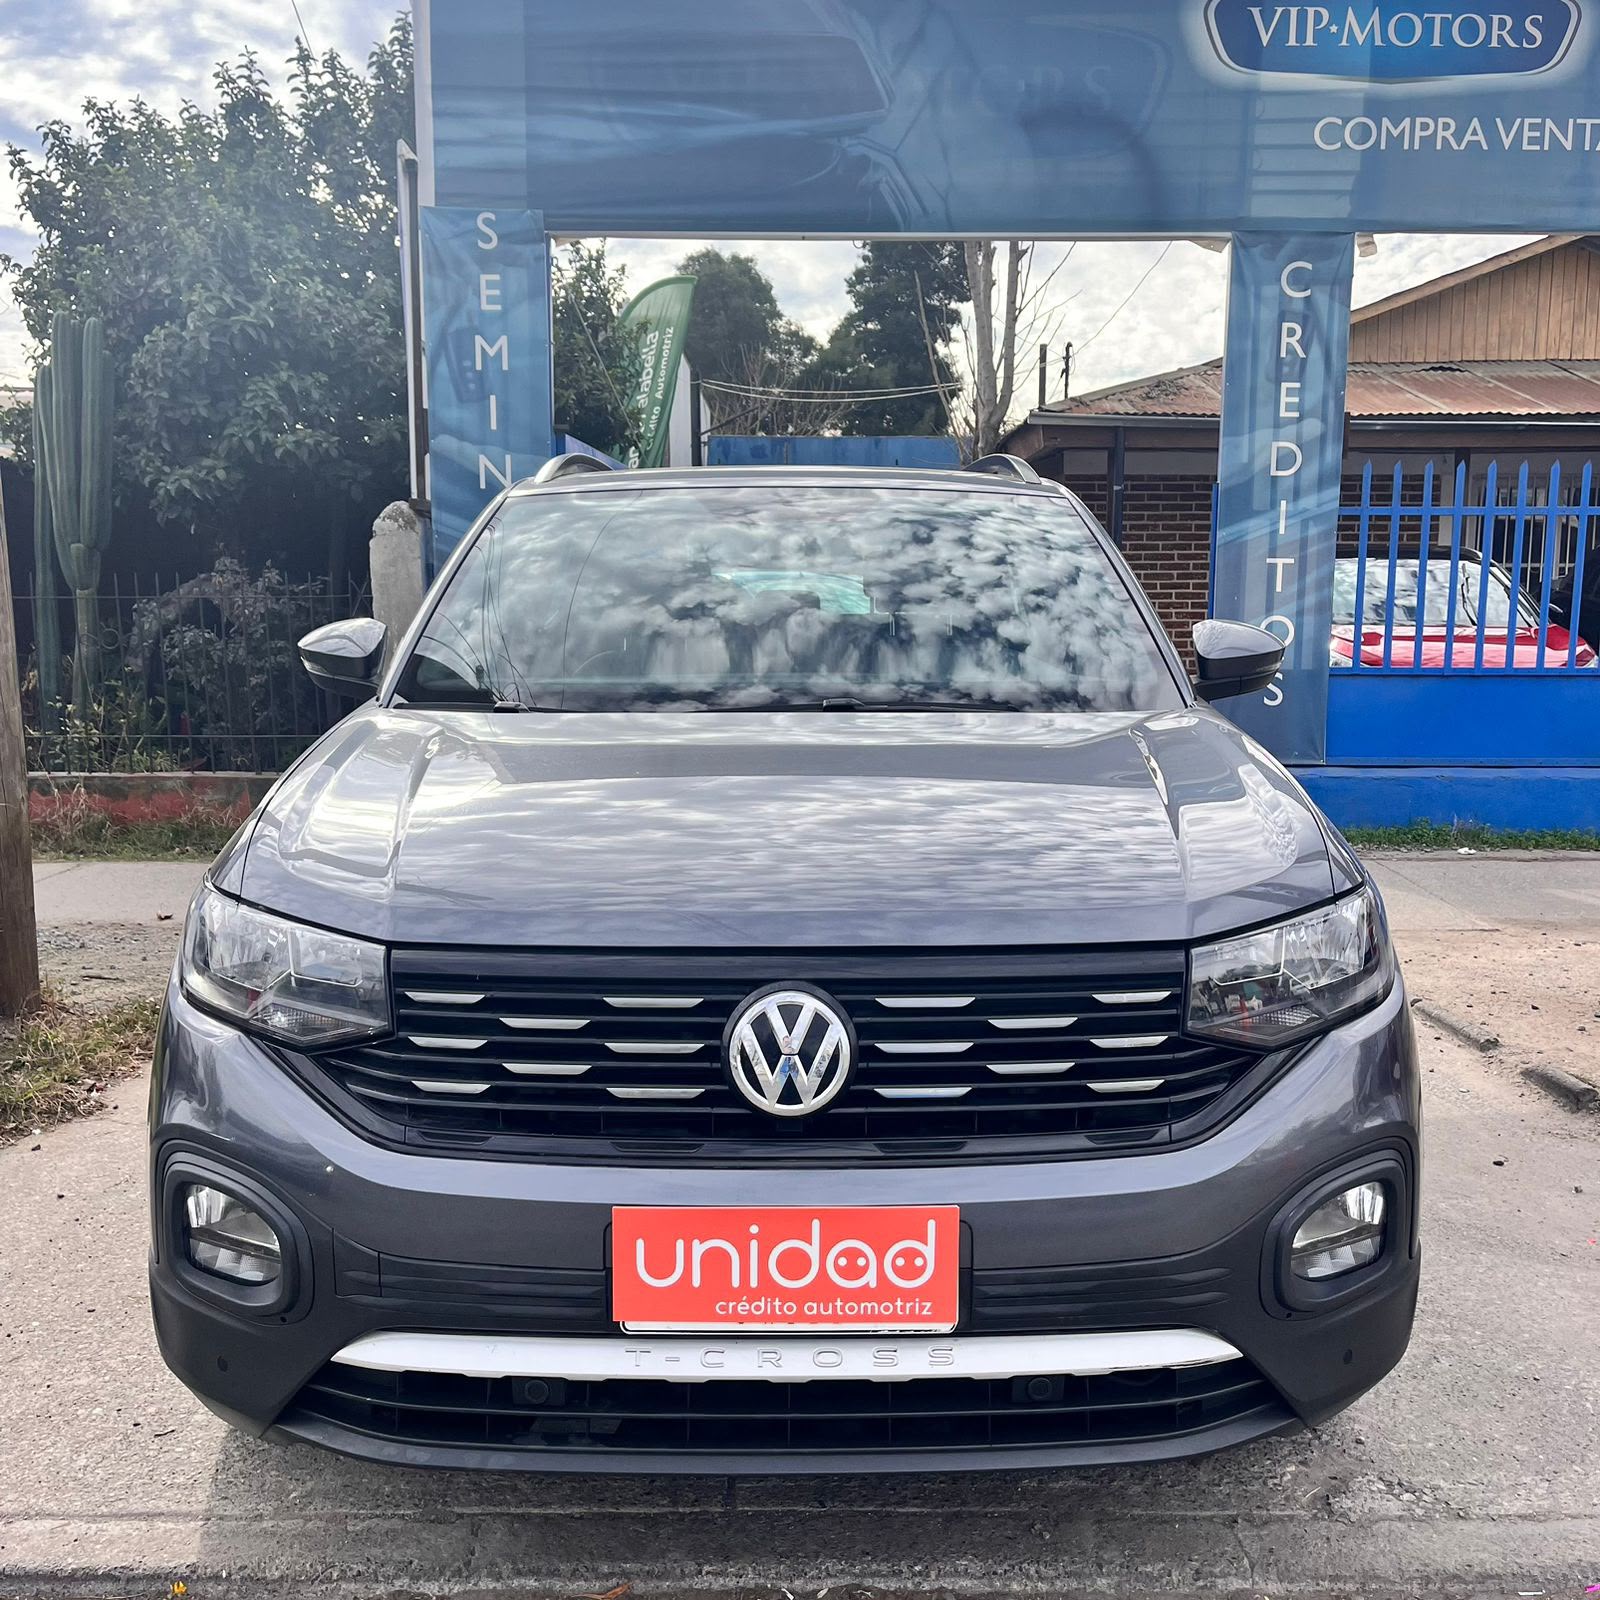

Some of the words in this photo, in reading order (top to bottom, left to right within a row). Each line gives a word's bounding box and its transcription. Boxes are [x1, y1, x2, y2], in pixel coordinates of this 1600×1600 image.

[1247, 6, 1331, 48] VIP
[1338, 6, 1543, 49] MOTORS
[1313, 116, 1488, 151] COMPRA
[1495, 117, 1600, 151] VENT
[636, 331, 659, 418] alabella
[635, 1218, 936, 1289] unidad
[715, 1295, 797, 1315] crédito
[804, 1297, 932, 1315] automotriz
[625, 1345, 954, 1369] T-CROSS
